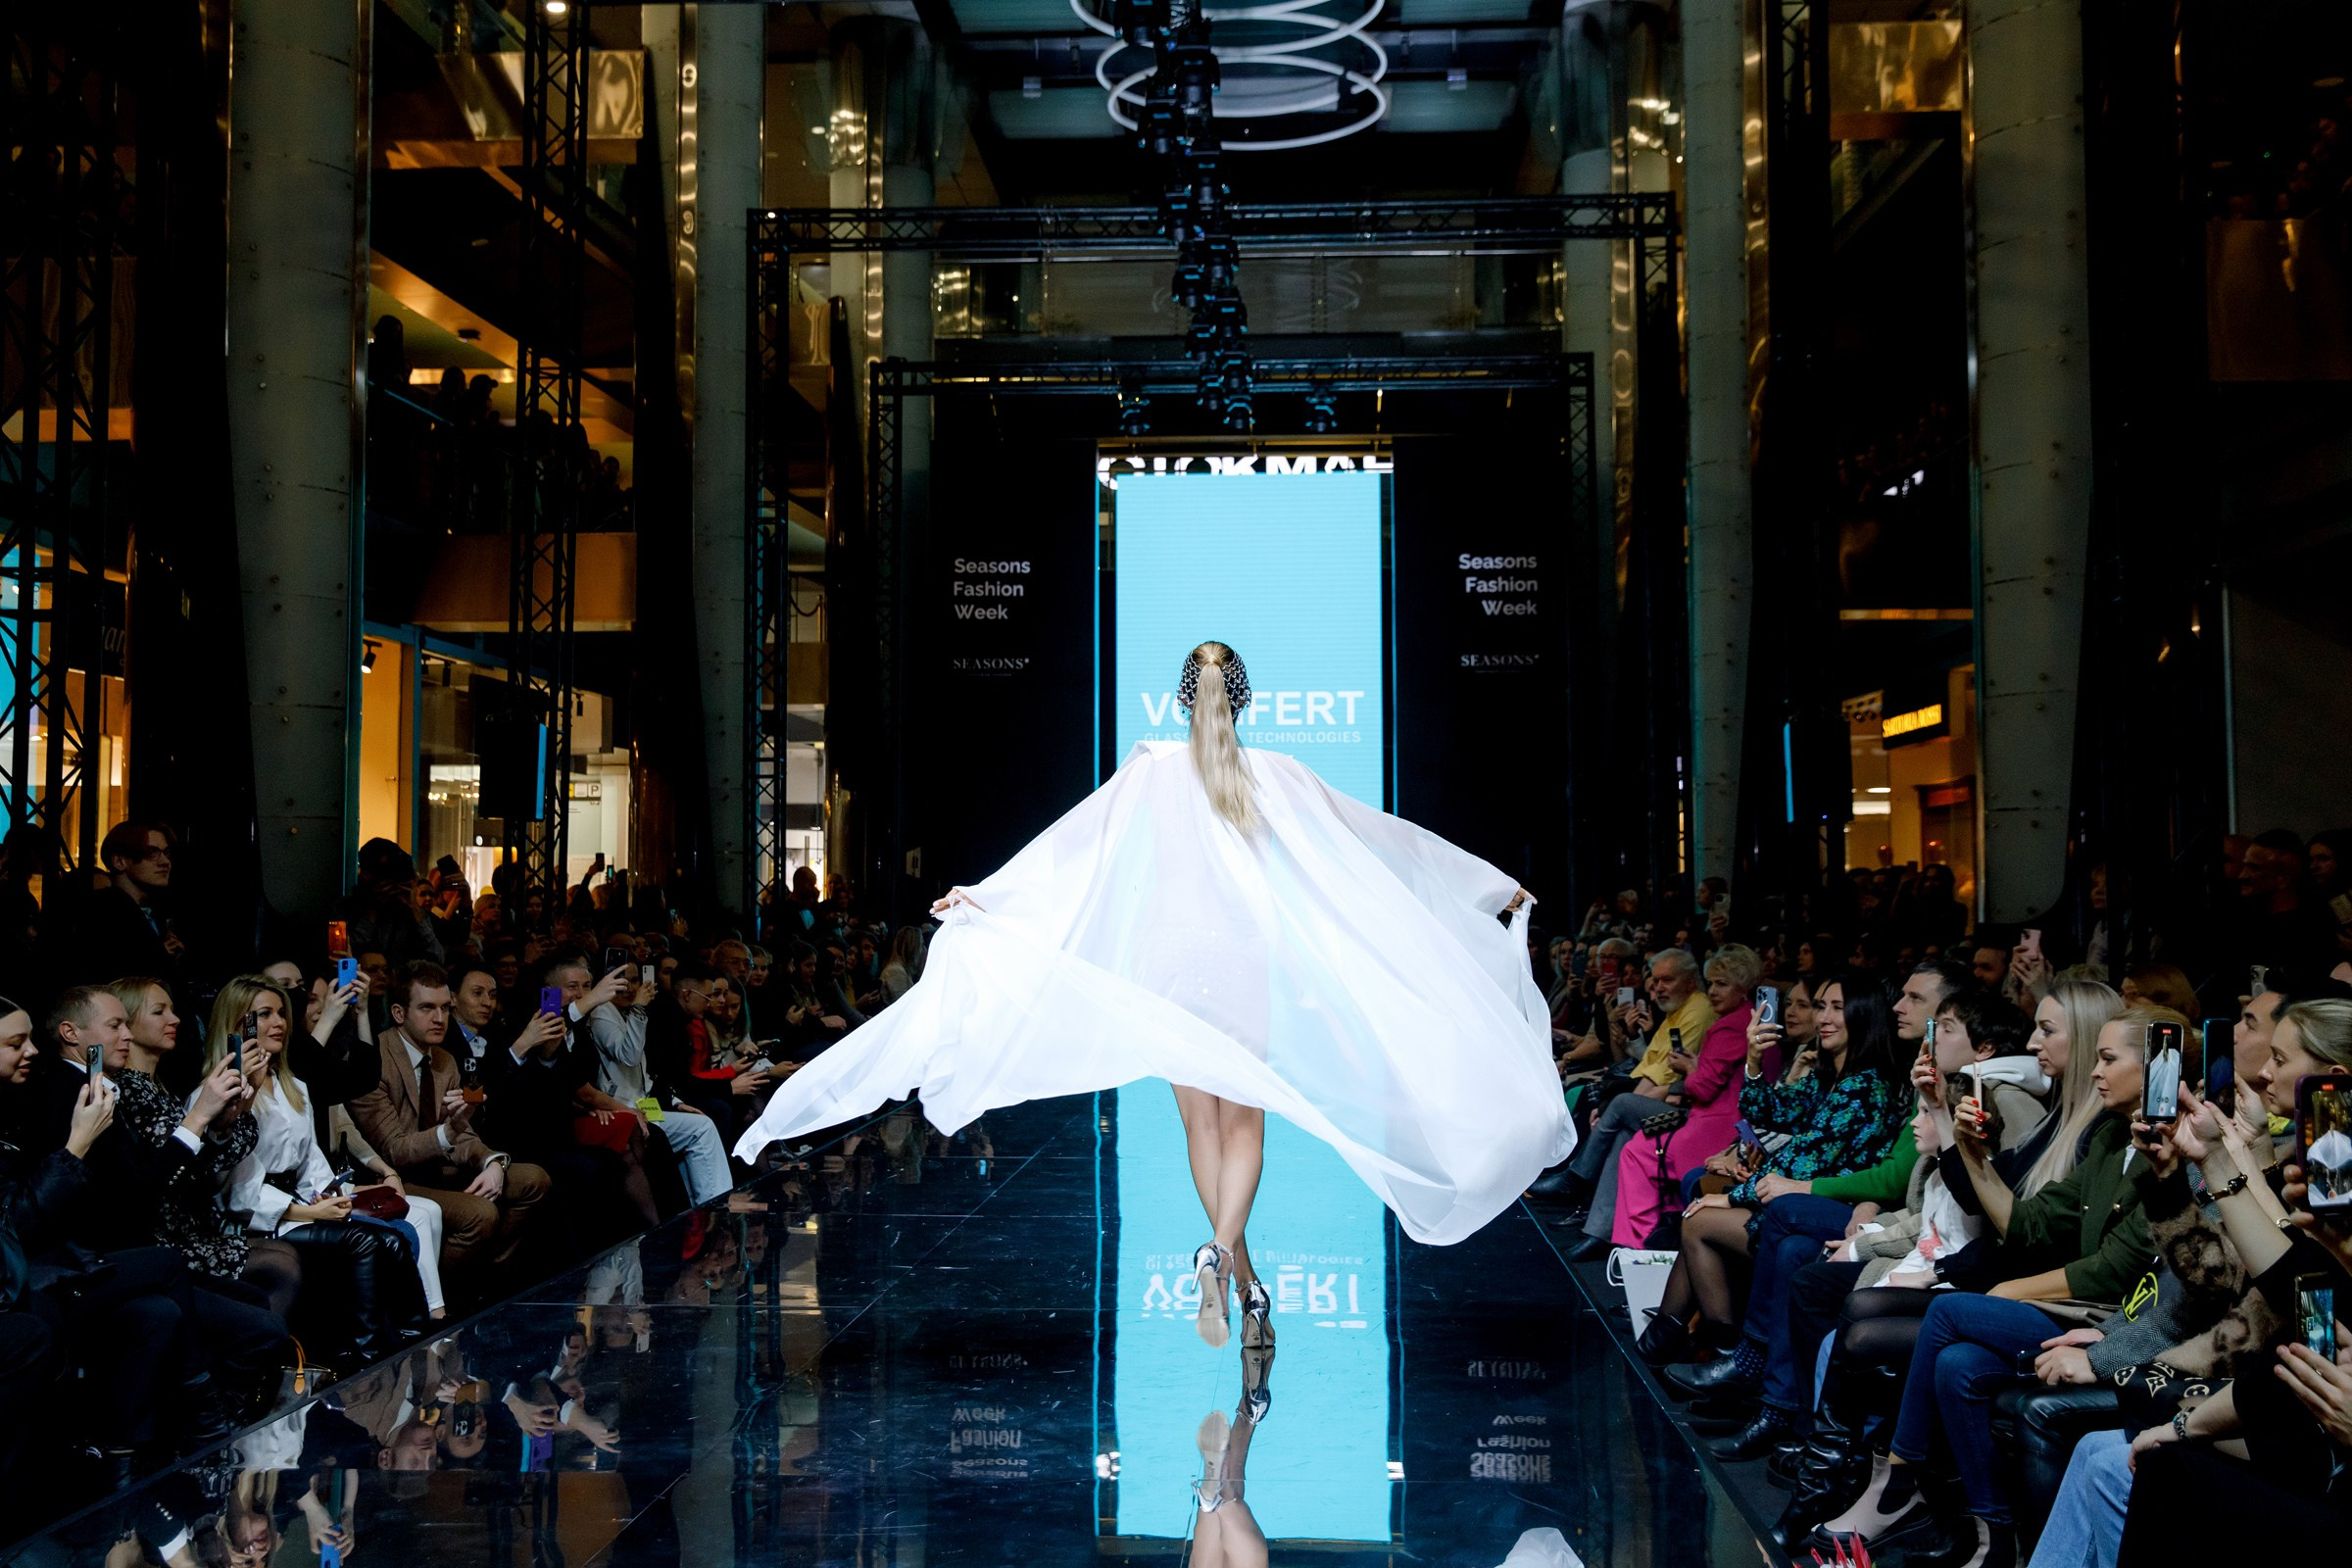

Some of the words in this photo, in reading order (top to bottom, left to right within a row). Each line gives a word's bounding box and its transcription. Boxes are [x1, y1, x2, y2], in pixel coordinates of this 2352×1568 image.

[955, 558, 1030, 573] Seasons
[1458, 554, 1537, 569] Seasons
[954, 580, 1024, 597] Fashion
[1465, 576, 1538, 593] Fashion
[954, 604, 1008, 619] Week
[1482, 600, 1538, 615] Week
[1248, 731, 1361, 744] TECHNOLOGIES
[591, 785, 599, 796] P
